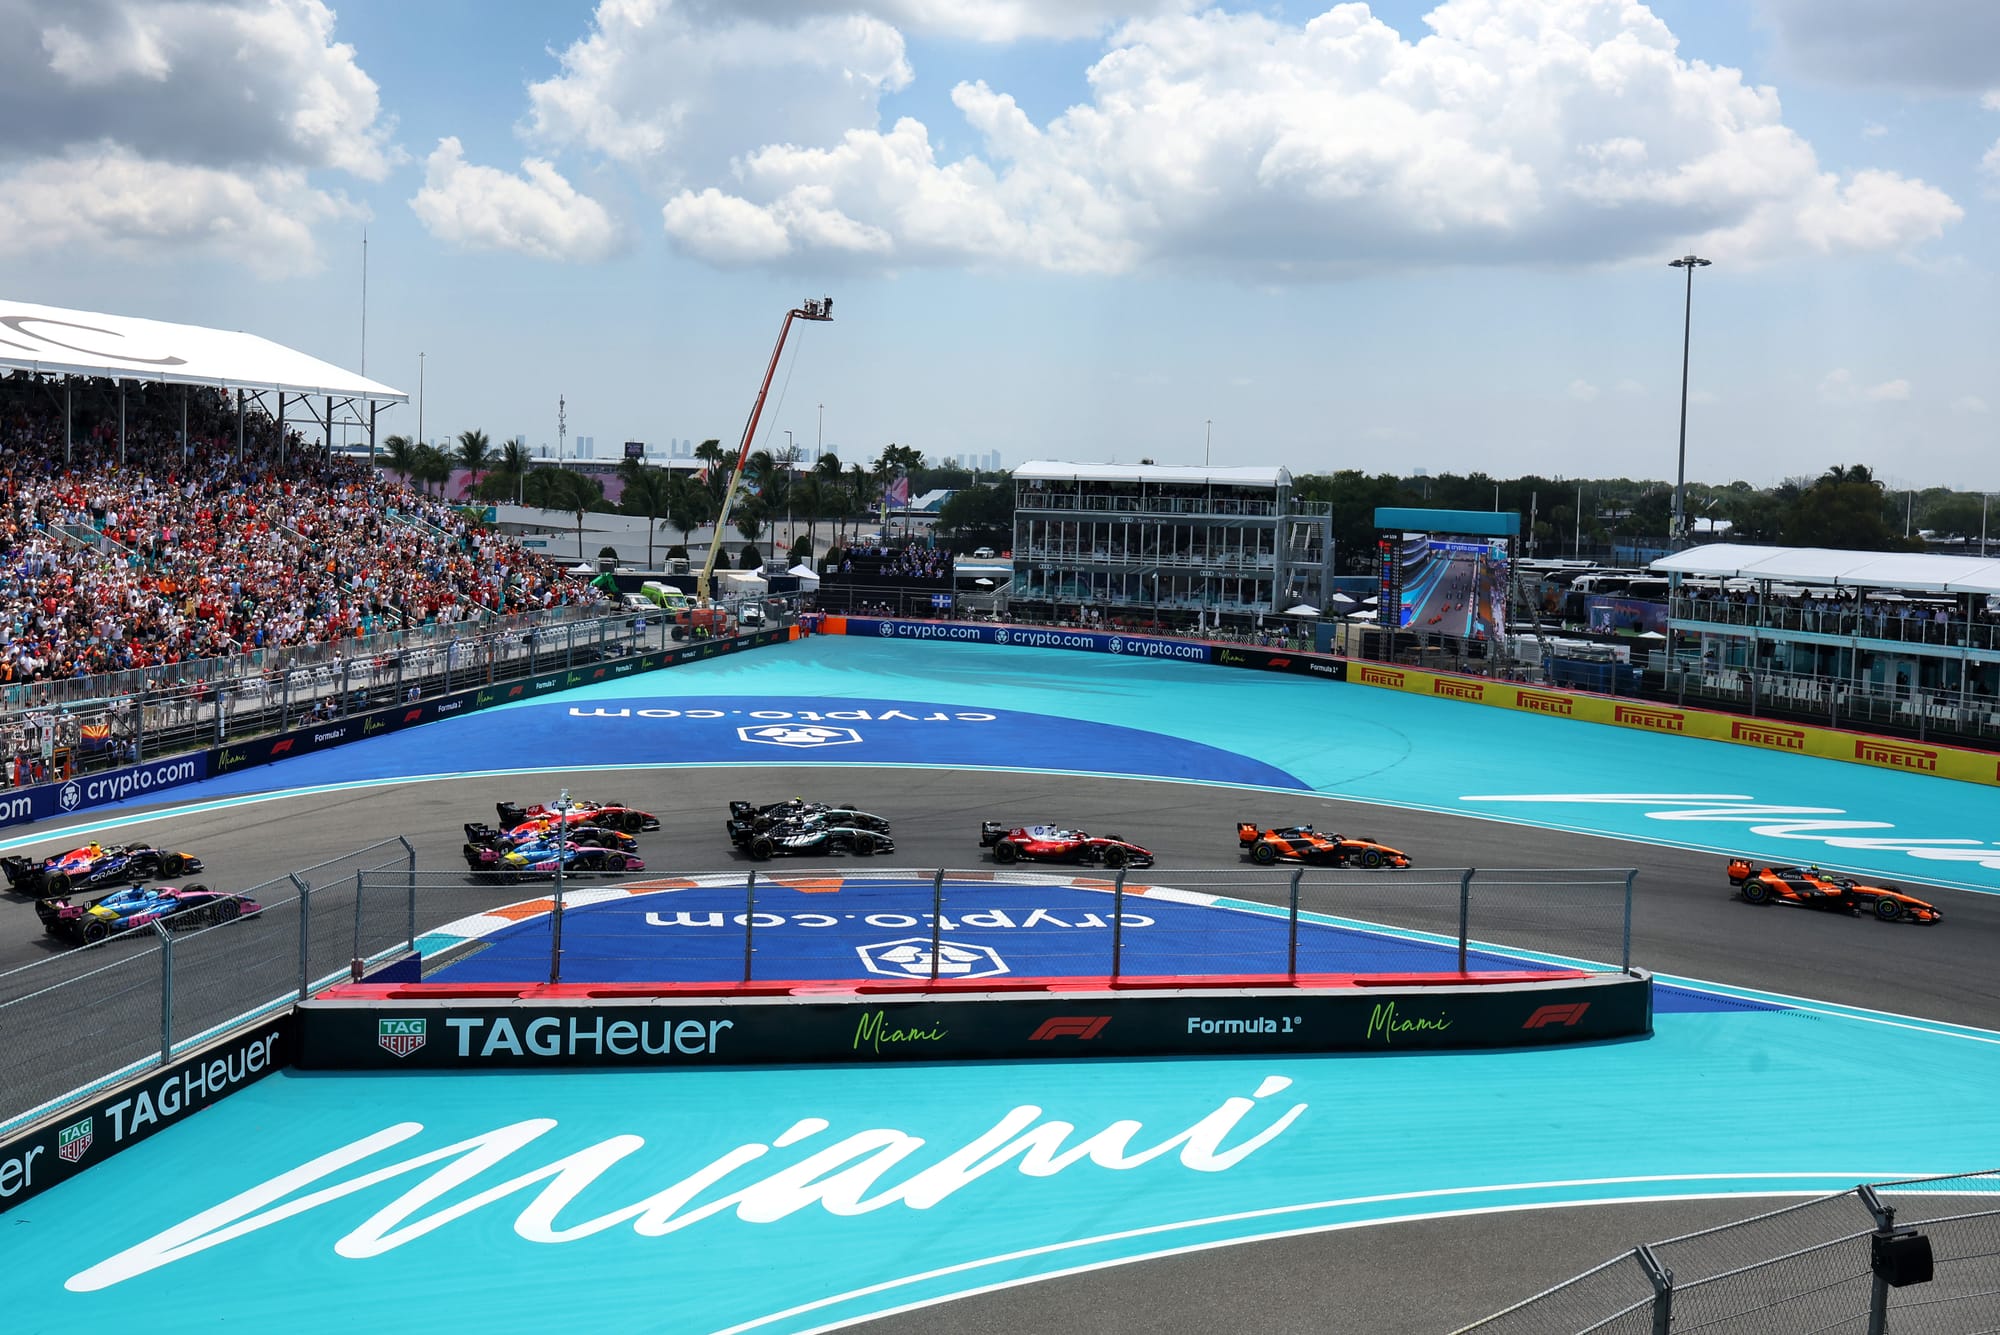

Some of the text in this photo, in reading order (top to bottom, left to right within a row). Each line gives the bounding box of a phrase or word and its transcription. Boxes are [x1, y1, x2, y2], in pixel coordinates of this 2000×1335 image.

[899, 624, 980, 640] crypto.com
[1013, 631, 1094, 648] crypto.com
[1127, 641, 1204, 659] crypto.com
[1310, 663, 1332, 673] Formula
[1361, 667, 1405, 688] PIRELLI
[1434, 678, 1484, 701] PIRELLI
[438, 702, 458, 713] Formula
[1516, 691, 1573, 715] PIRELLI
[569, 706, 997, 723] crypto.com
[1615, 705, 1685, 731] PIRELLI
[314, 731, 339, 743] Formula
[1731, 721, 1805, 750] PIRELLI
[218, 748, 248, 770] Miami
[1855, 740, 1938, 771] PIRELLI
[87, 760, 195, 800] crypto.com
[90, 863, 127, 882] ORACLE
[645, 908, 1156, 931] crypto.com
[383, 1021, 422, 1034] TAG
[853, 1010, 949, 1055] Miami
[1187, 1016, 1277, 1034] Formula
[1366, 1001, 1454, 1044] Miami
[381, 1036, 424, 1055] HEUER
[62, 1120, 90, 1143] TAG
[61, 1134, 91, 1160] HEUER
[65, 1076, 1308, 1293] Miami
